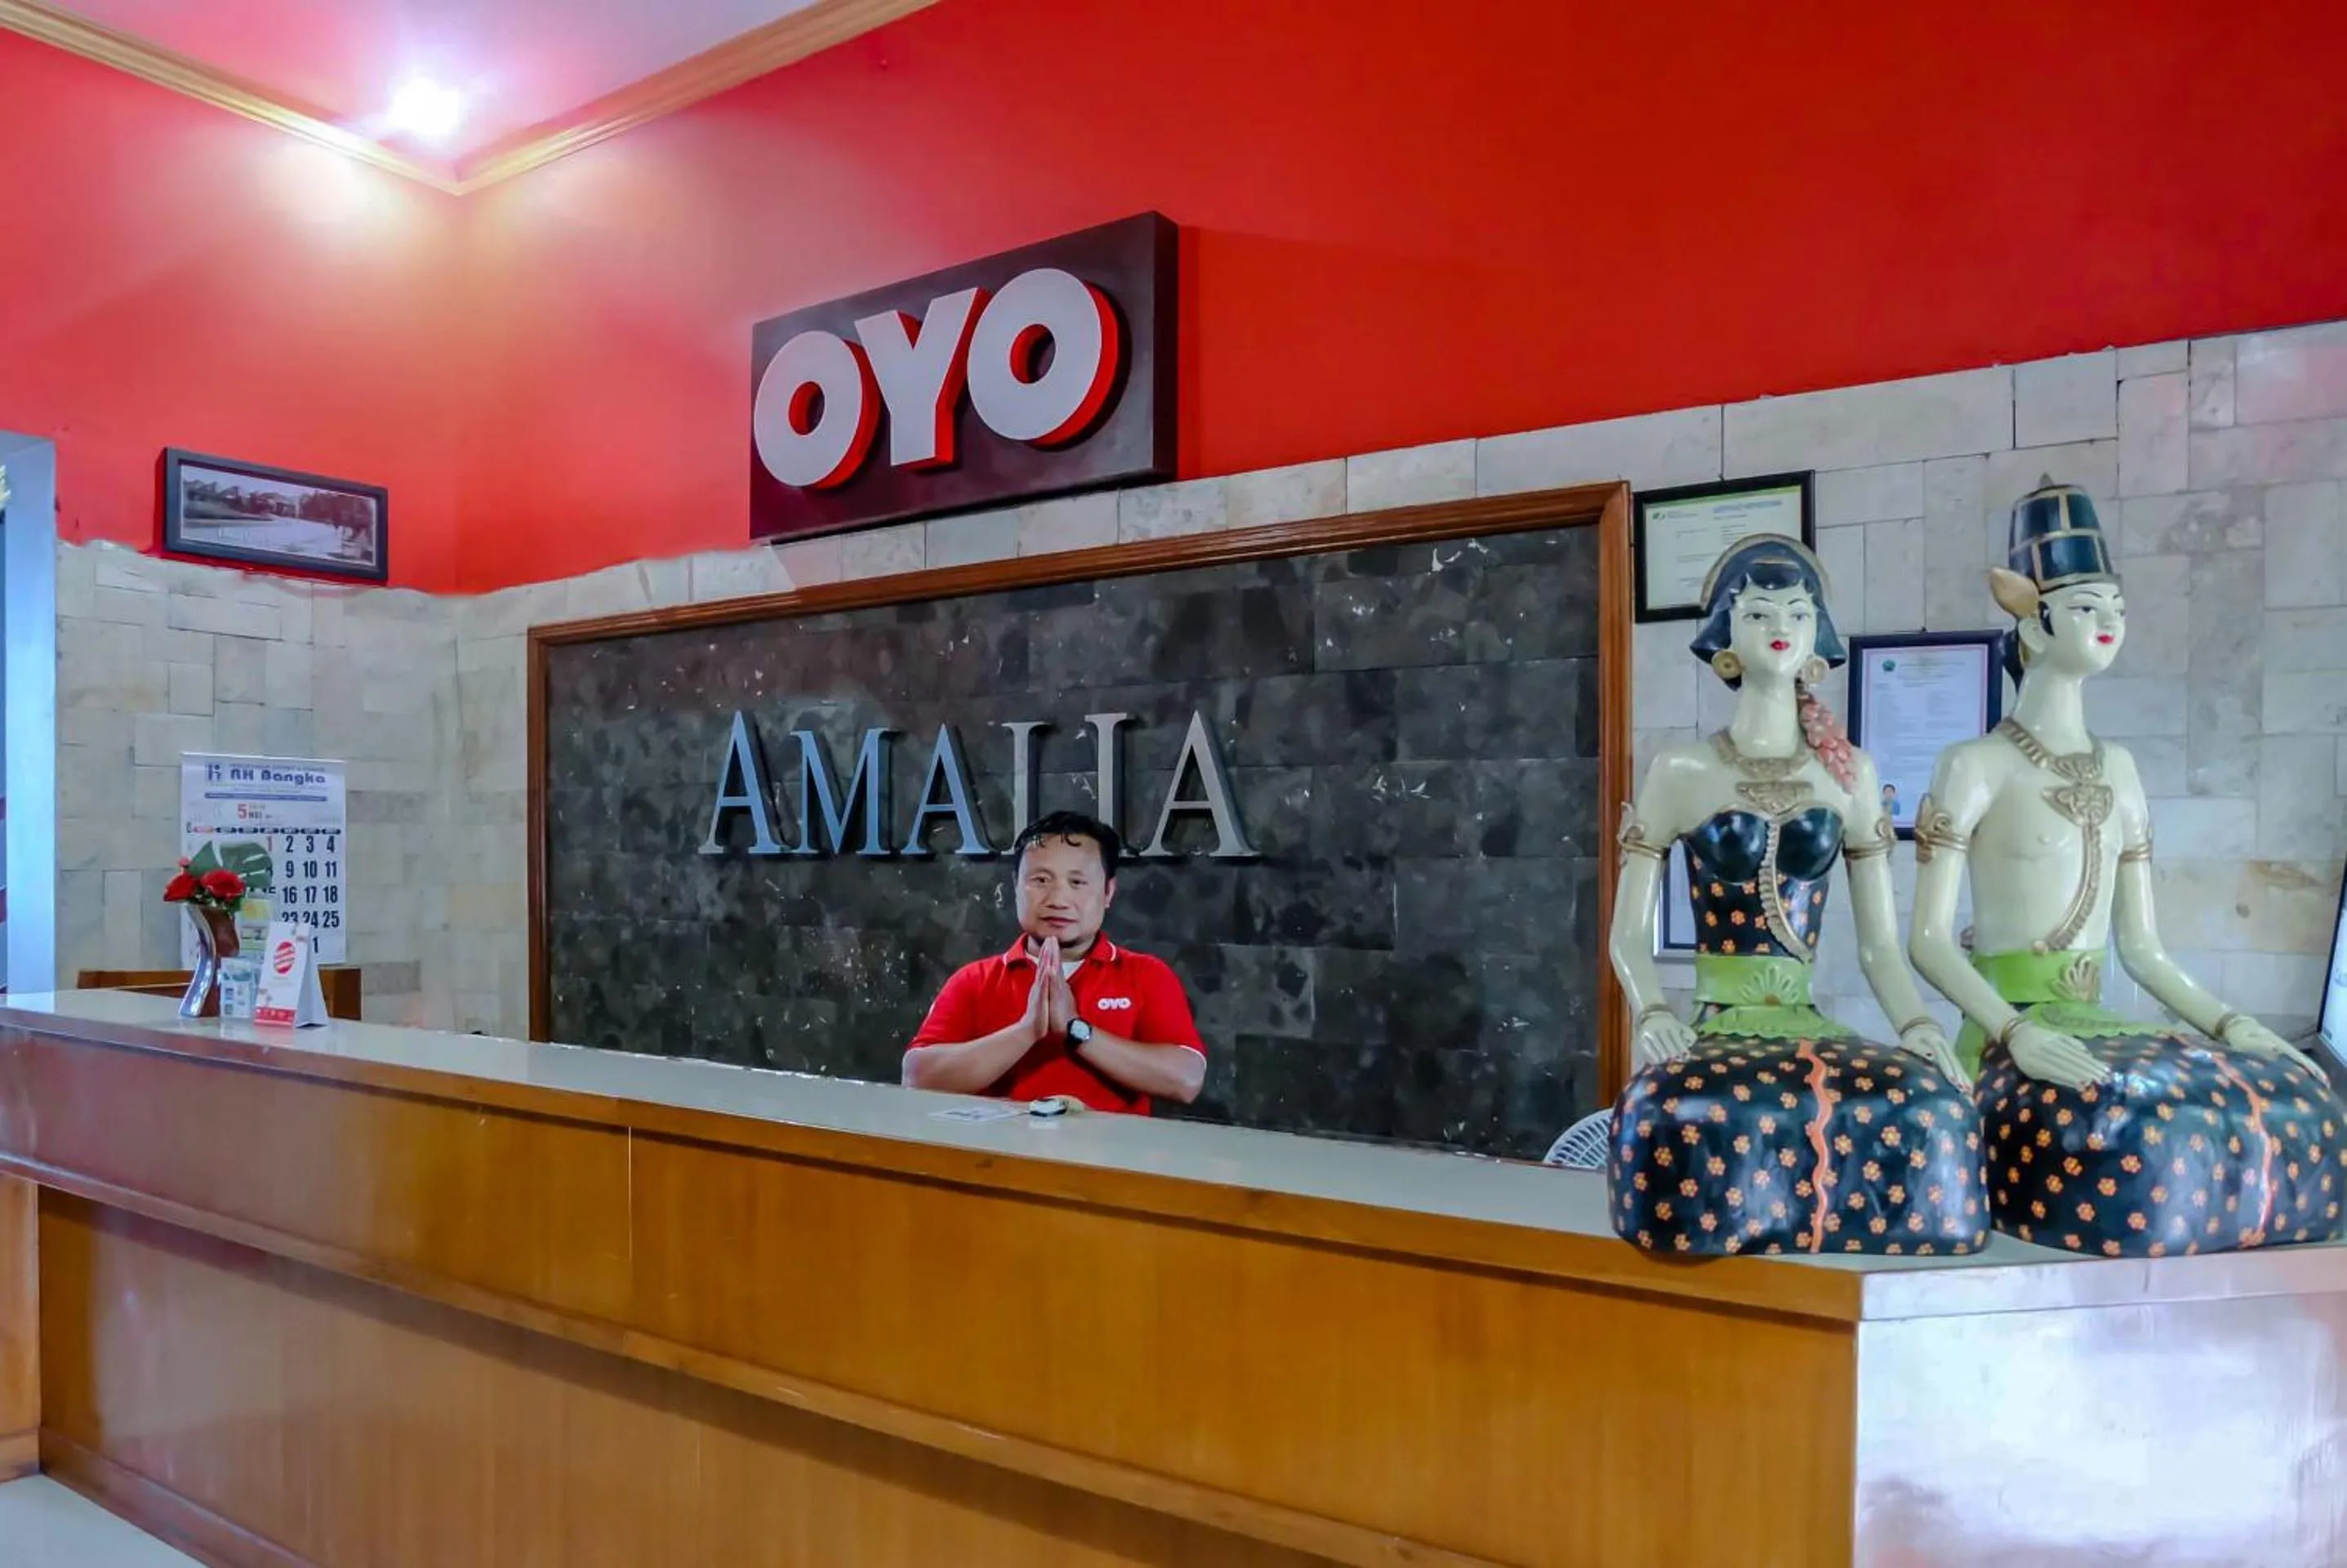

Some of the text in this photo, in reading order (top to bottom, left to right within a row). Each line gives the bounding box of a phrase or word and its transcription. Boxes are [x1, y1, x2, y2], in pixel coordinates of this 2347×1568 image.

[753, 268, 1111, 488] OYO
[697, 710, 1261, 858] AMALIA
[237, 803, 247, 819] 5
[266, 835, 336, 853] 1 2 3 4
[285, 860, 295, 879] 9
[302, 860, 318, 879] 10
[324, 860, 337, 879] 11
[282, 885, 298, 904] 16
[304, 885, 318, 904] 17
[323, 884, 339, 904] 18
[302, 910, 319, 929] 24
[322, 910, 341, 929] 25
[1098, 998, 1132, 1010] OYO
